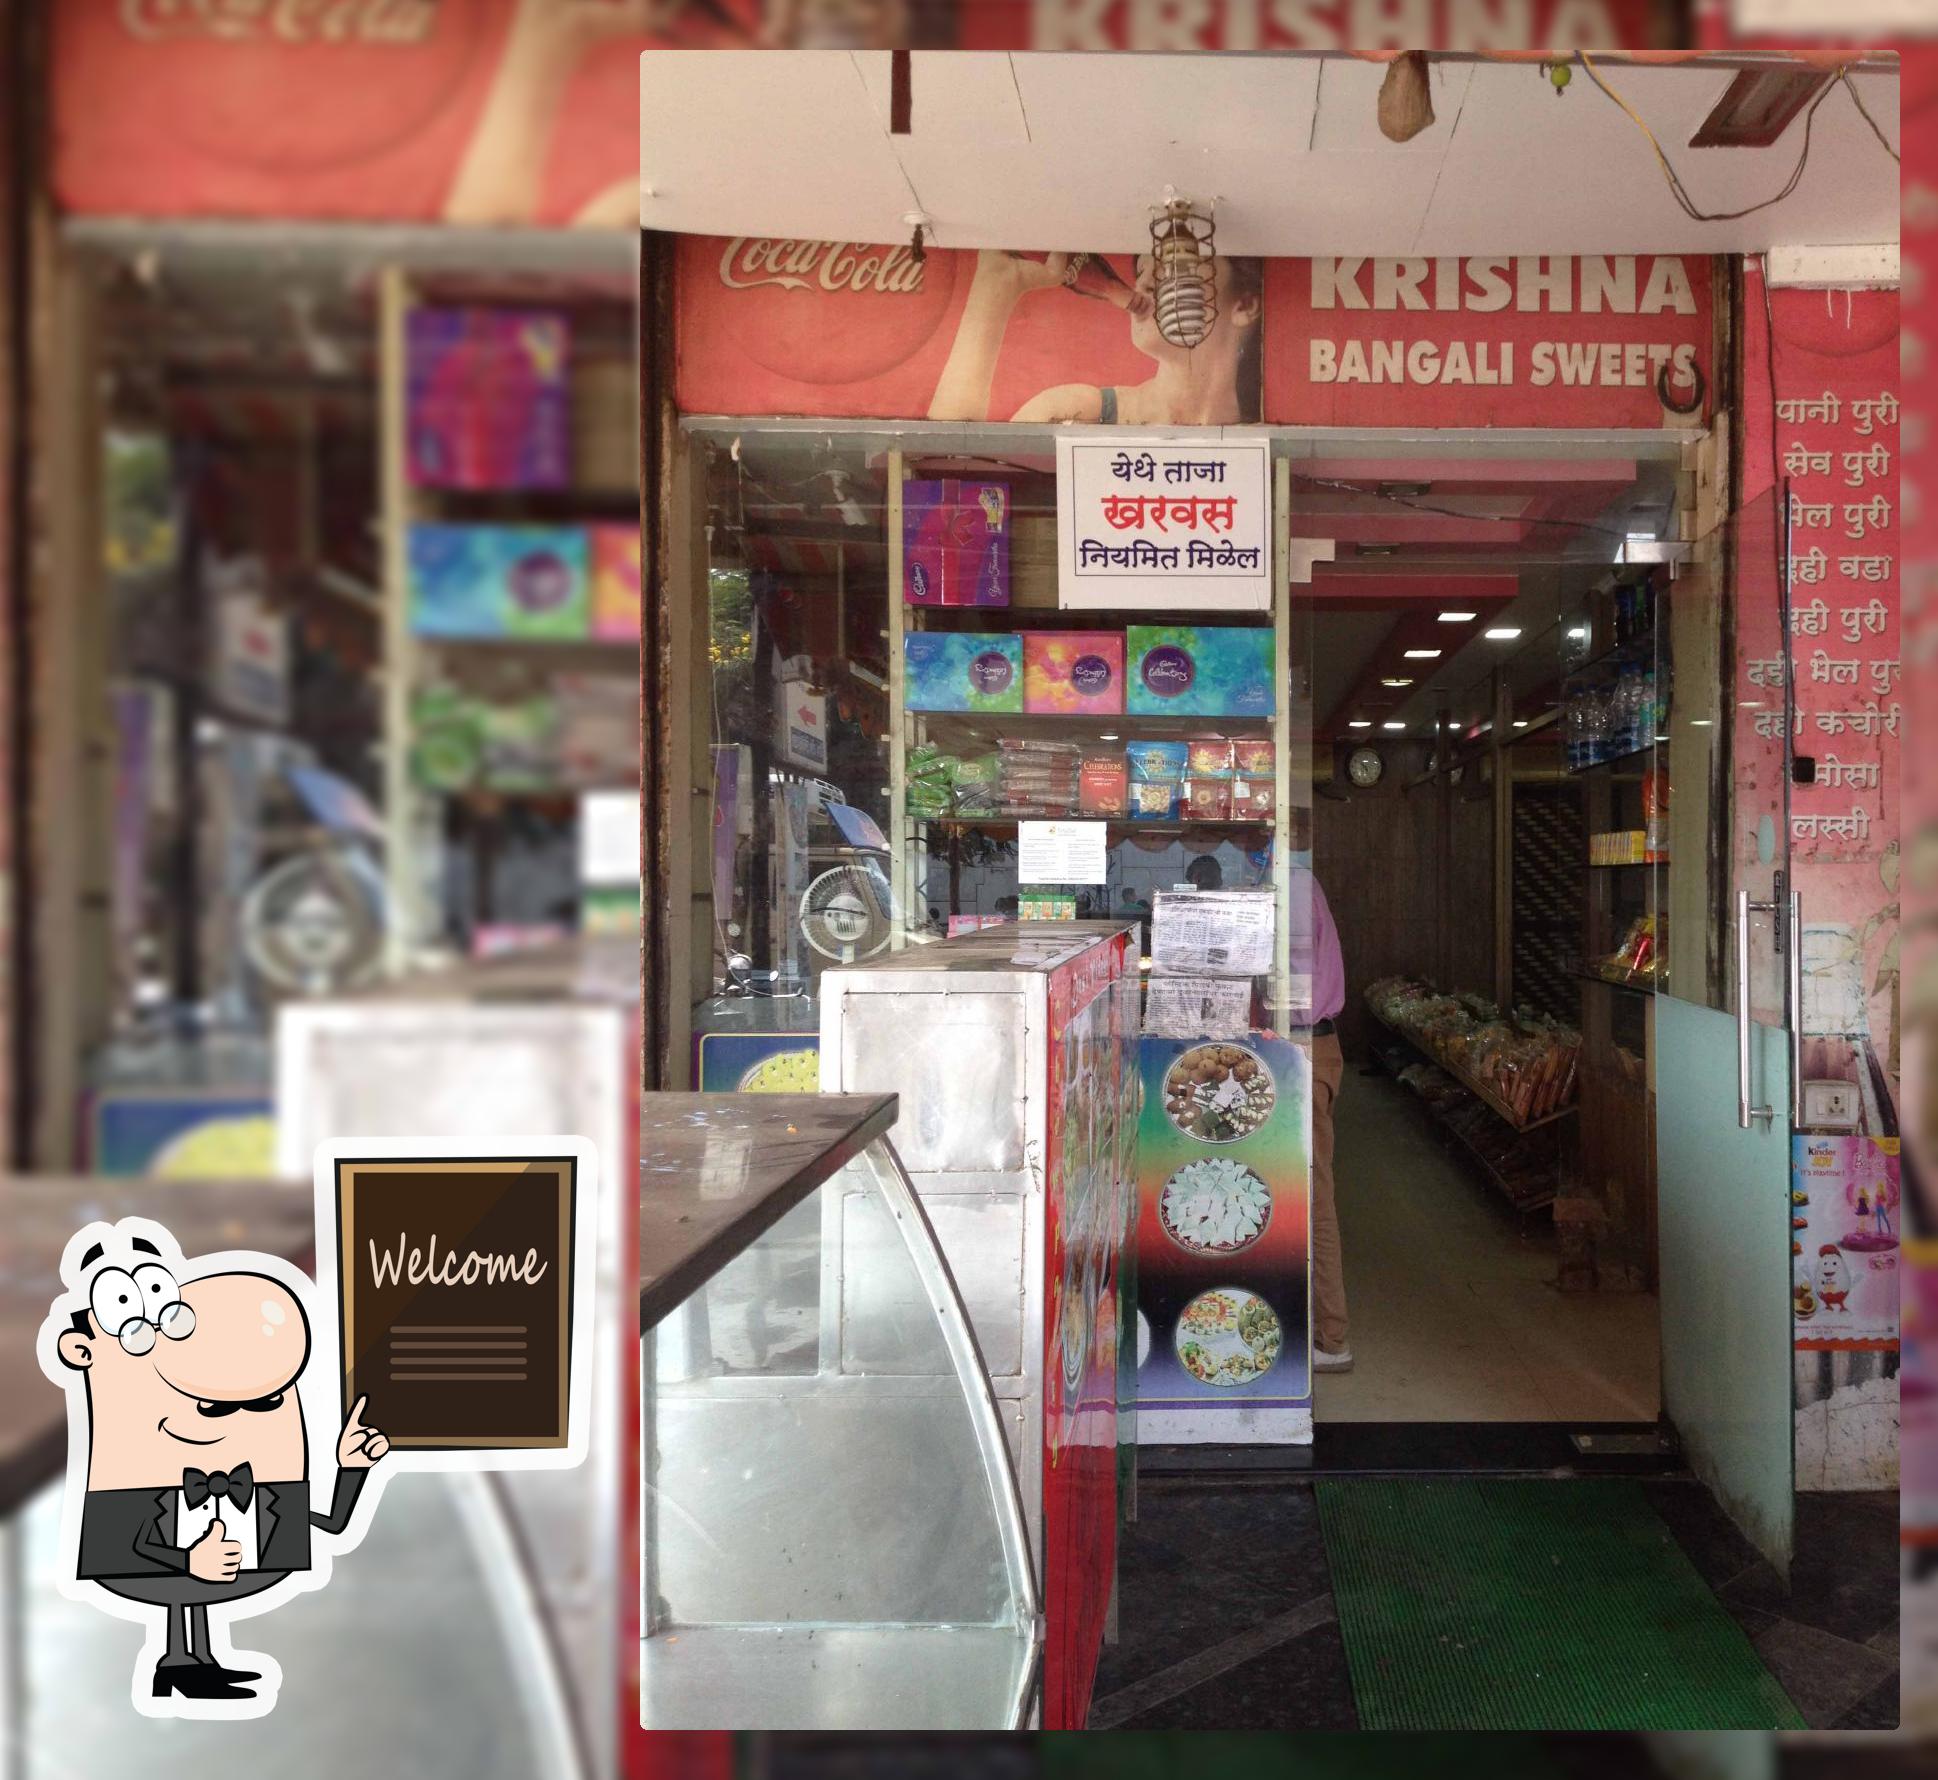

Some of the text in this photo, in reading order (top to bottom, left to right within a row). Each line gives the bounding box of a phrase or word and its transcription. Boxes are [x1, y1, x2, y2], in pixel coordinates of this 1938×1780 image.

[1311, 255, 1697, 315] KRISHNA
[1309, 339, 1697, 388] BANGALI SWEETS
[1775, 391, 1900, 434] पानी पुरी
[1111, 452, 1227, 484] येथे ताजा
[1783, 441, 1891, 486] सेव पुरी
[1101, 494, 1238, 534] खरवस
[1842, 494, 1892, 538] पुरी
[1079, 538, 1260, 570] नियमित मिळेल
[1838, 554, 1893, 580] वडा
[1840, 598, 1888, 642] पुरी
[1809, 649, 1861, 683] भेल
[1804, 753, 1880, 791] मोसा
[1791, 806, 1871, 841] लस्सी
